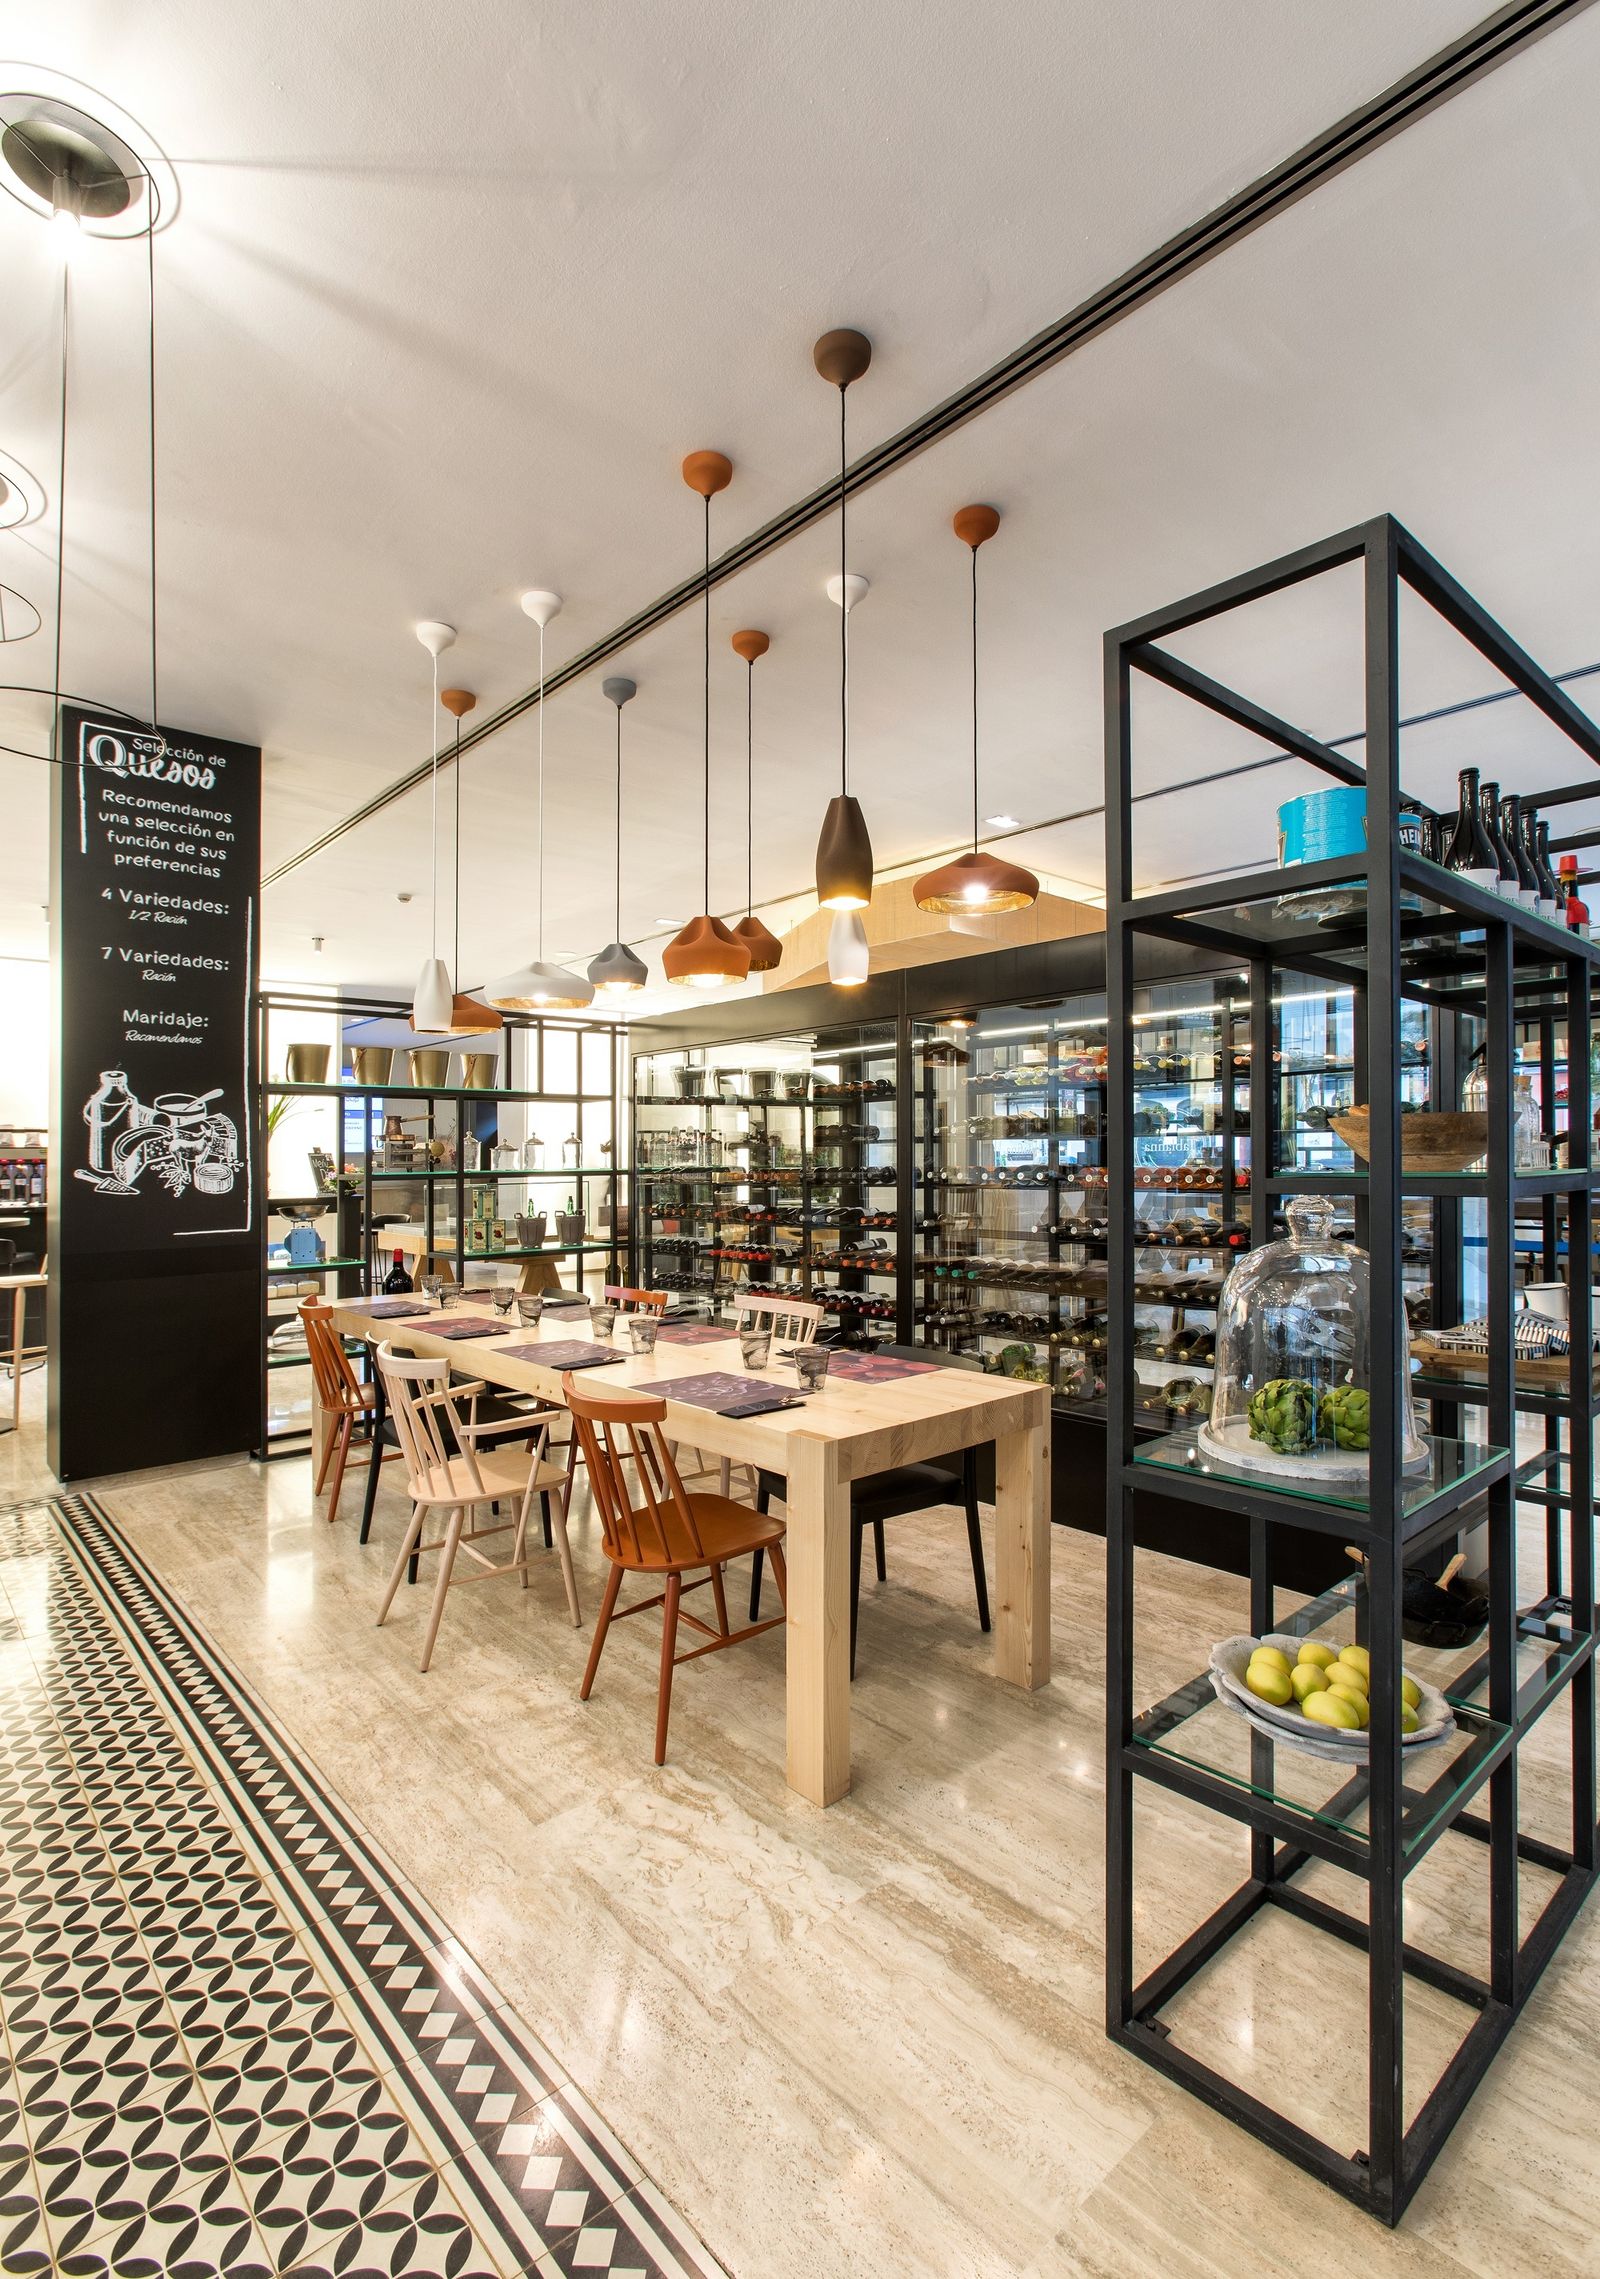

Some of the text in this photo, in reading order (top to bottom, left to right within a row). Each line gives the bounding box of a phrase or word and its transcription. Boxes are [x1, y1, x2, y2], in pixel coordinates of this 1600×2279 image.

[89, 734, 216, 790] Quesos
[132, 738, 227, 768] Selección de
[102, 788, 233, 824] Recomendamos
[98, 811, 235, 842] una selección en
[107, 829, 227, 860] función de sus
[114, 853, 221, 878] preferencias
[101, 887, 230, 915] 4 Variedades:
[128, 909, 189, 925] 1/2 Ración
[101, 946, 230, 971] 7 Variedades:
[141, 969, 177, 982] Ración
[122, 1009, 210, 1029] Maridaje:
[125, 1029, 204, 1045] Recomendamos
